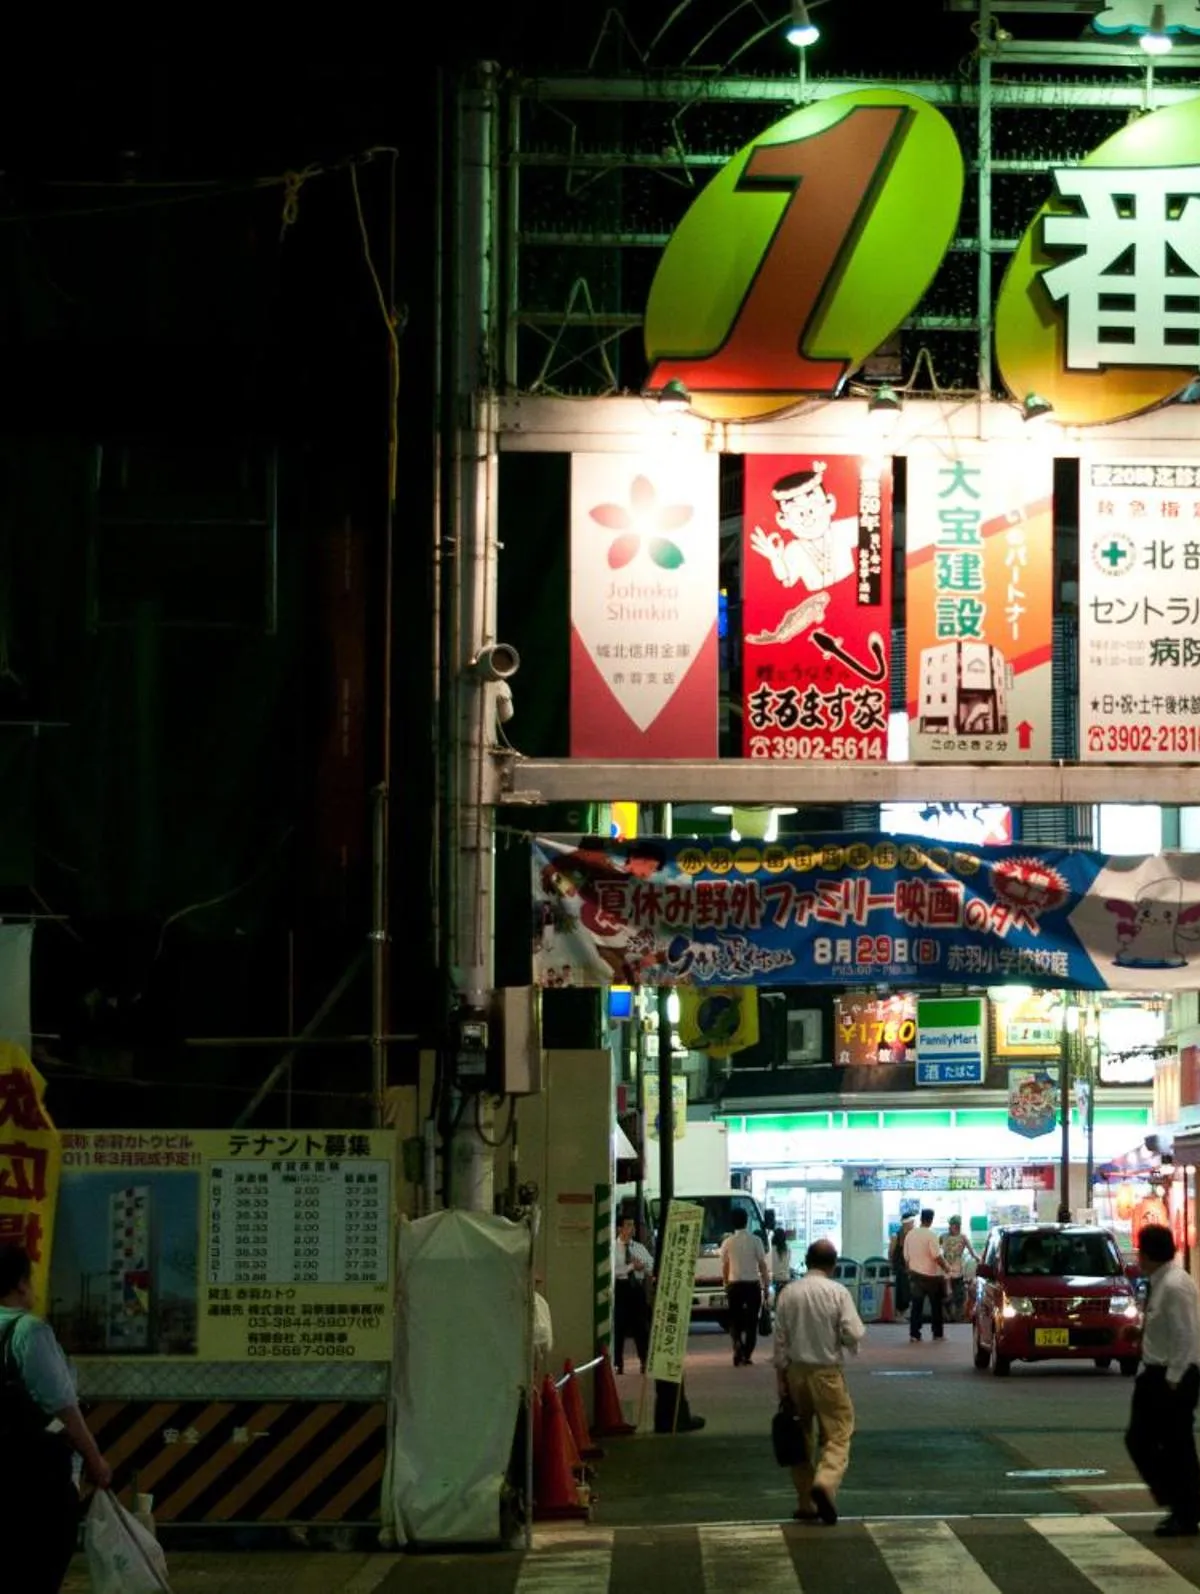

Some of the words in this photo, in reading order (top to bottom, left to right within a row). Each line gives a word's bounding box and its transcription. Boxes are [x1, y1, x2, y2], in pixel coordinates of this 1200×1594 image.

[935, 460, 985, 639] 大宝建設
[607, 603, 679, 621] Shinkin
[596, 643, 691, 659] 城北信用金庫
[613, 672, 675, 685] 赤羽支店
[749, 682, 886, 731] まるます家
[919, 1033, 978, 1046] FamilyMart
[924, 1064, 940, 1080] 酒
[944, 1064, 977, 1078] たばこ
[229, 1134, 371, 1157] テナント募集
[61, 1152, 202, 1166] 011年3月完成予定!!
[248, 1304, 296, 1315] 株式会社
[162, 1426, 199, 1444] 安全
